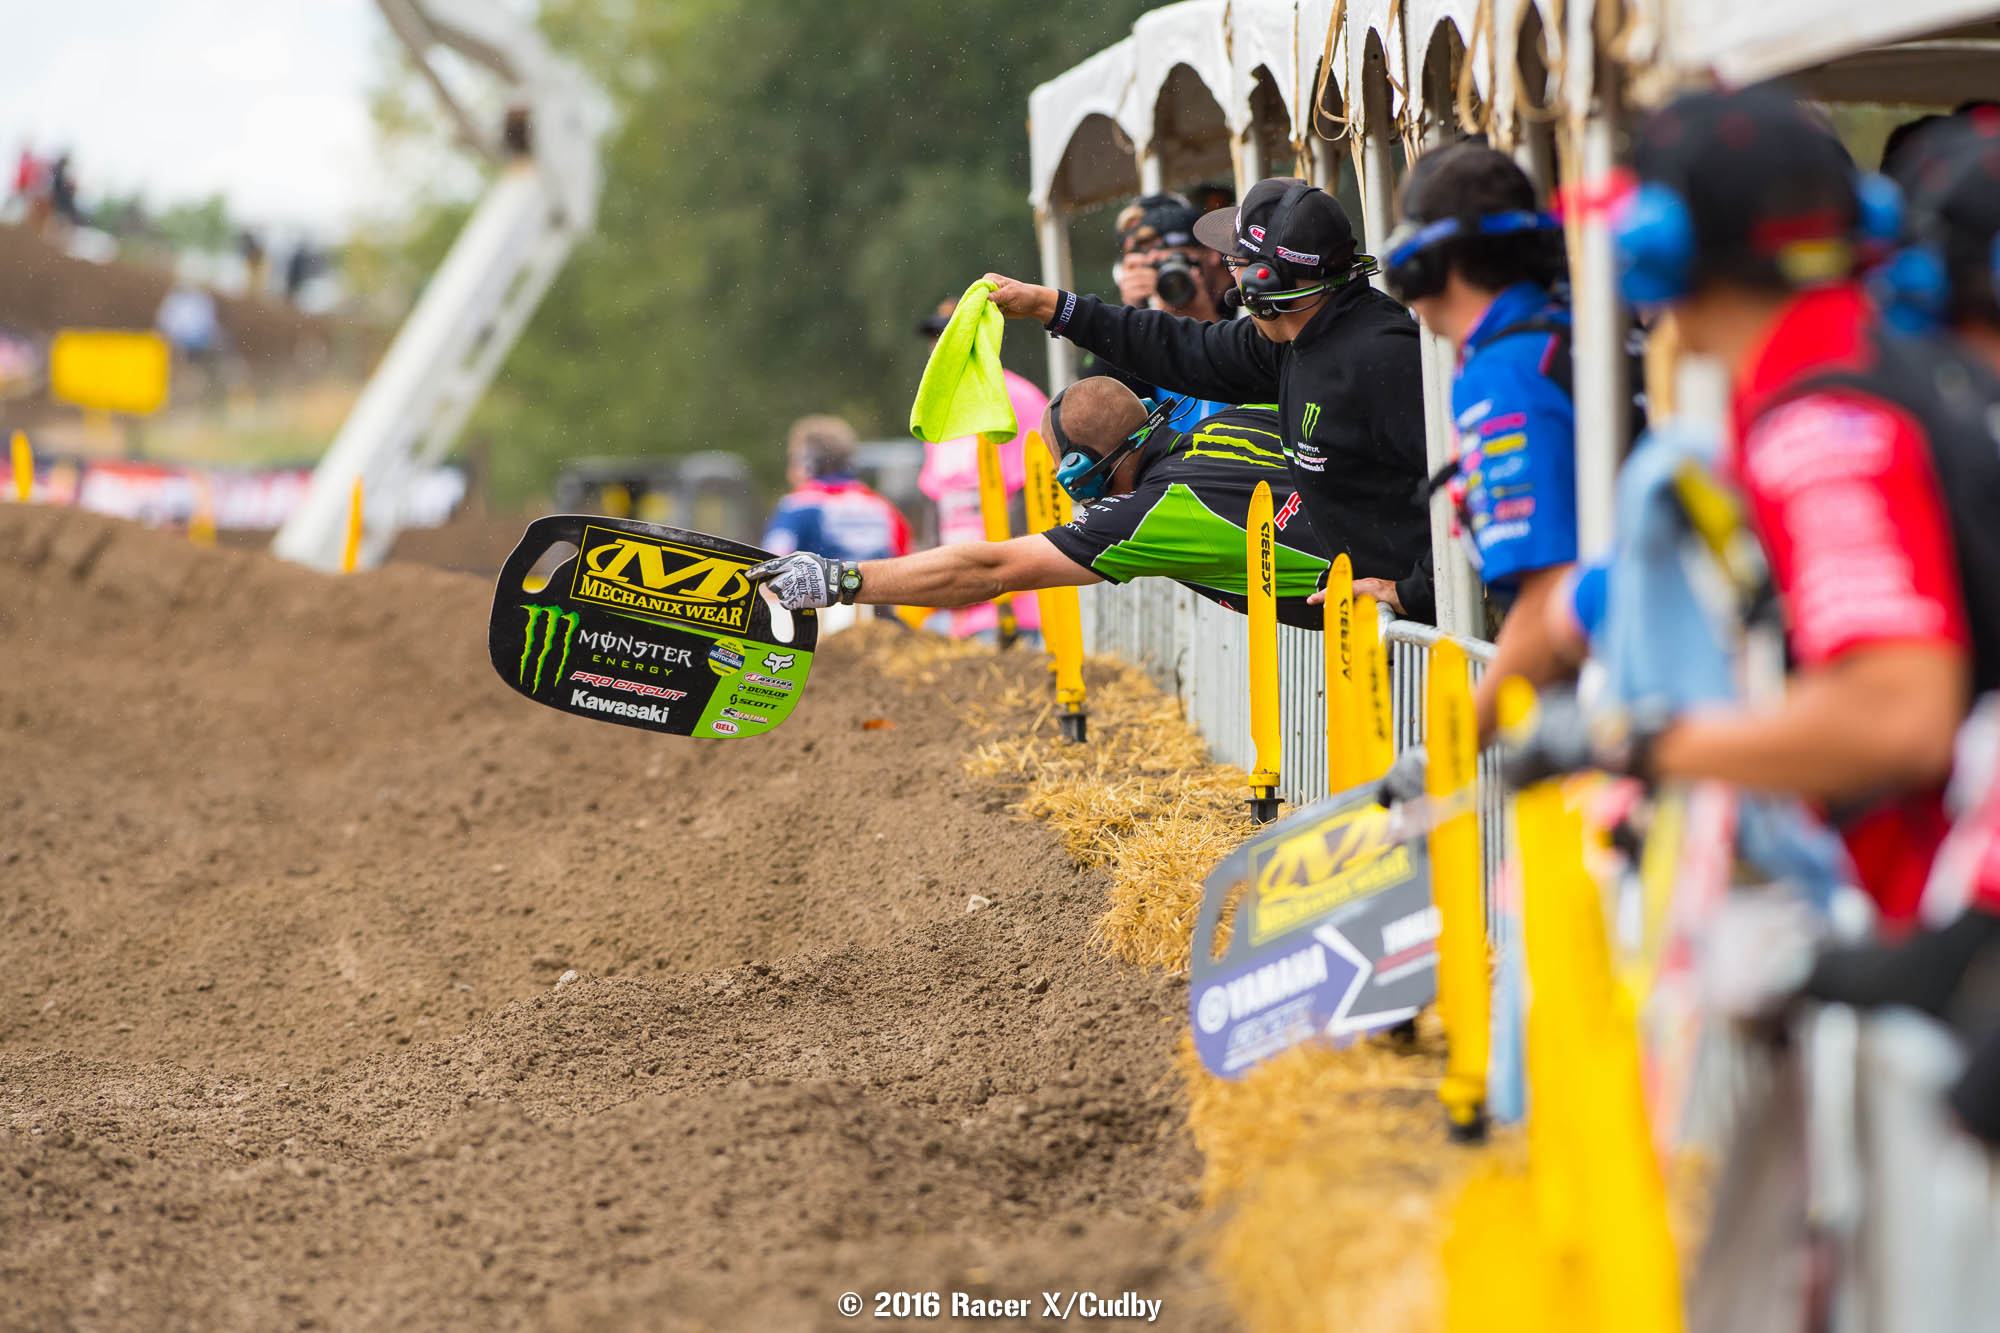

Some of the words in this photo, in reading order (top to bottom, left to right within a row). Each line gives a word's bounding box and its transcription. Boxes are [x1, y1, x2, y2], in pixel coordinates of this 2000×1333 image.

[1261, 521, 1272, 598] ACERBIS
[578, 574, 682, 616] MECHANIX
[685, 604, 744, 627] WEAR
[592, 654, 673, 677] ENERGY
[570, 671, 614, 688] PRO
[612, 679, 688, 701] CIRCUIT
[747, 685, 789, 698] DUNLOP
[571, 689, 670, 724] Kawasaki
[738, 698, 779, 710] SCOTT
[715, 722, 735, 732] BELL
